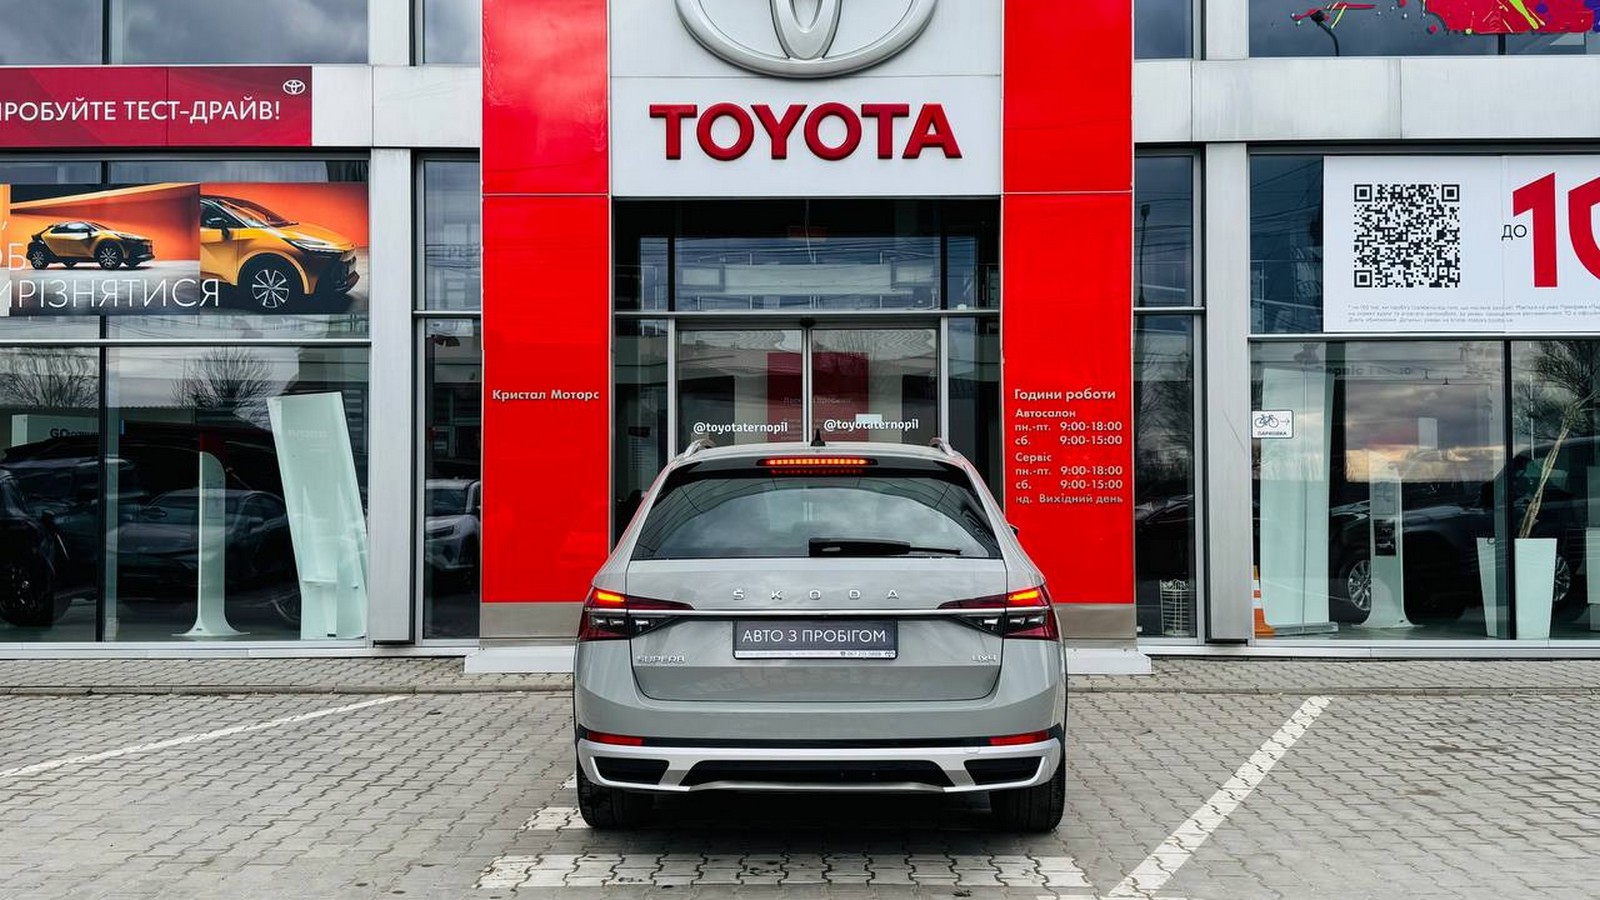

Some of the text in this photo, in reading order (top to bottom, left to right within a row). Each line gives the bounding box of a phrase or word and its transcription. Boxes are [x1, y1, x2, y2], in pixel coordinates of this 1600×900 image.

[0, 96, 280, 124] РОБУЙТЕ ТЕСТ-ДРАЙВ!
[649, 102, 962, 161] TOYOTA
[0, 243, 26, 271] Б
[492, 389, 600, 402] Кристал Моторс
[1014, 387, 1116, 402] Години роботи
[1015, 408, 1076, 418] Автосалон
[693, 421, 788, 435] @toyotaternopil
[823, 418, 919, 432] @toyotaternopil
[1059, 421, 1123, 432] 9:00-18:00
[1014, 435, 1123, 446] сб. 9:00-15:00
[1015, 452, 1053, 464] Сервіс
[1060, 465, 1123, 476] 9:00-18:00
[1015, 479, 1123, 490] сб. 9:00-15:00
[1015, 493, 1123, 504] нд. Вихідний день
[732, 587, 899, 601] ŠKODA
[742, 629, 886, 643] АВТО З ПРОБІГОМ
[636, 654, 686, 665] SUPERB
